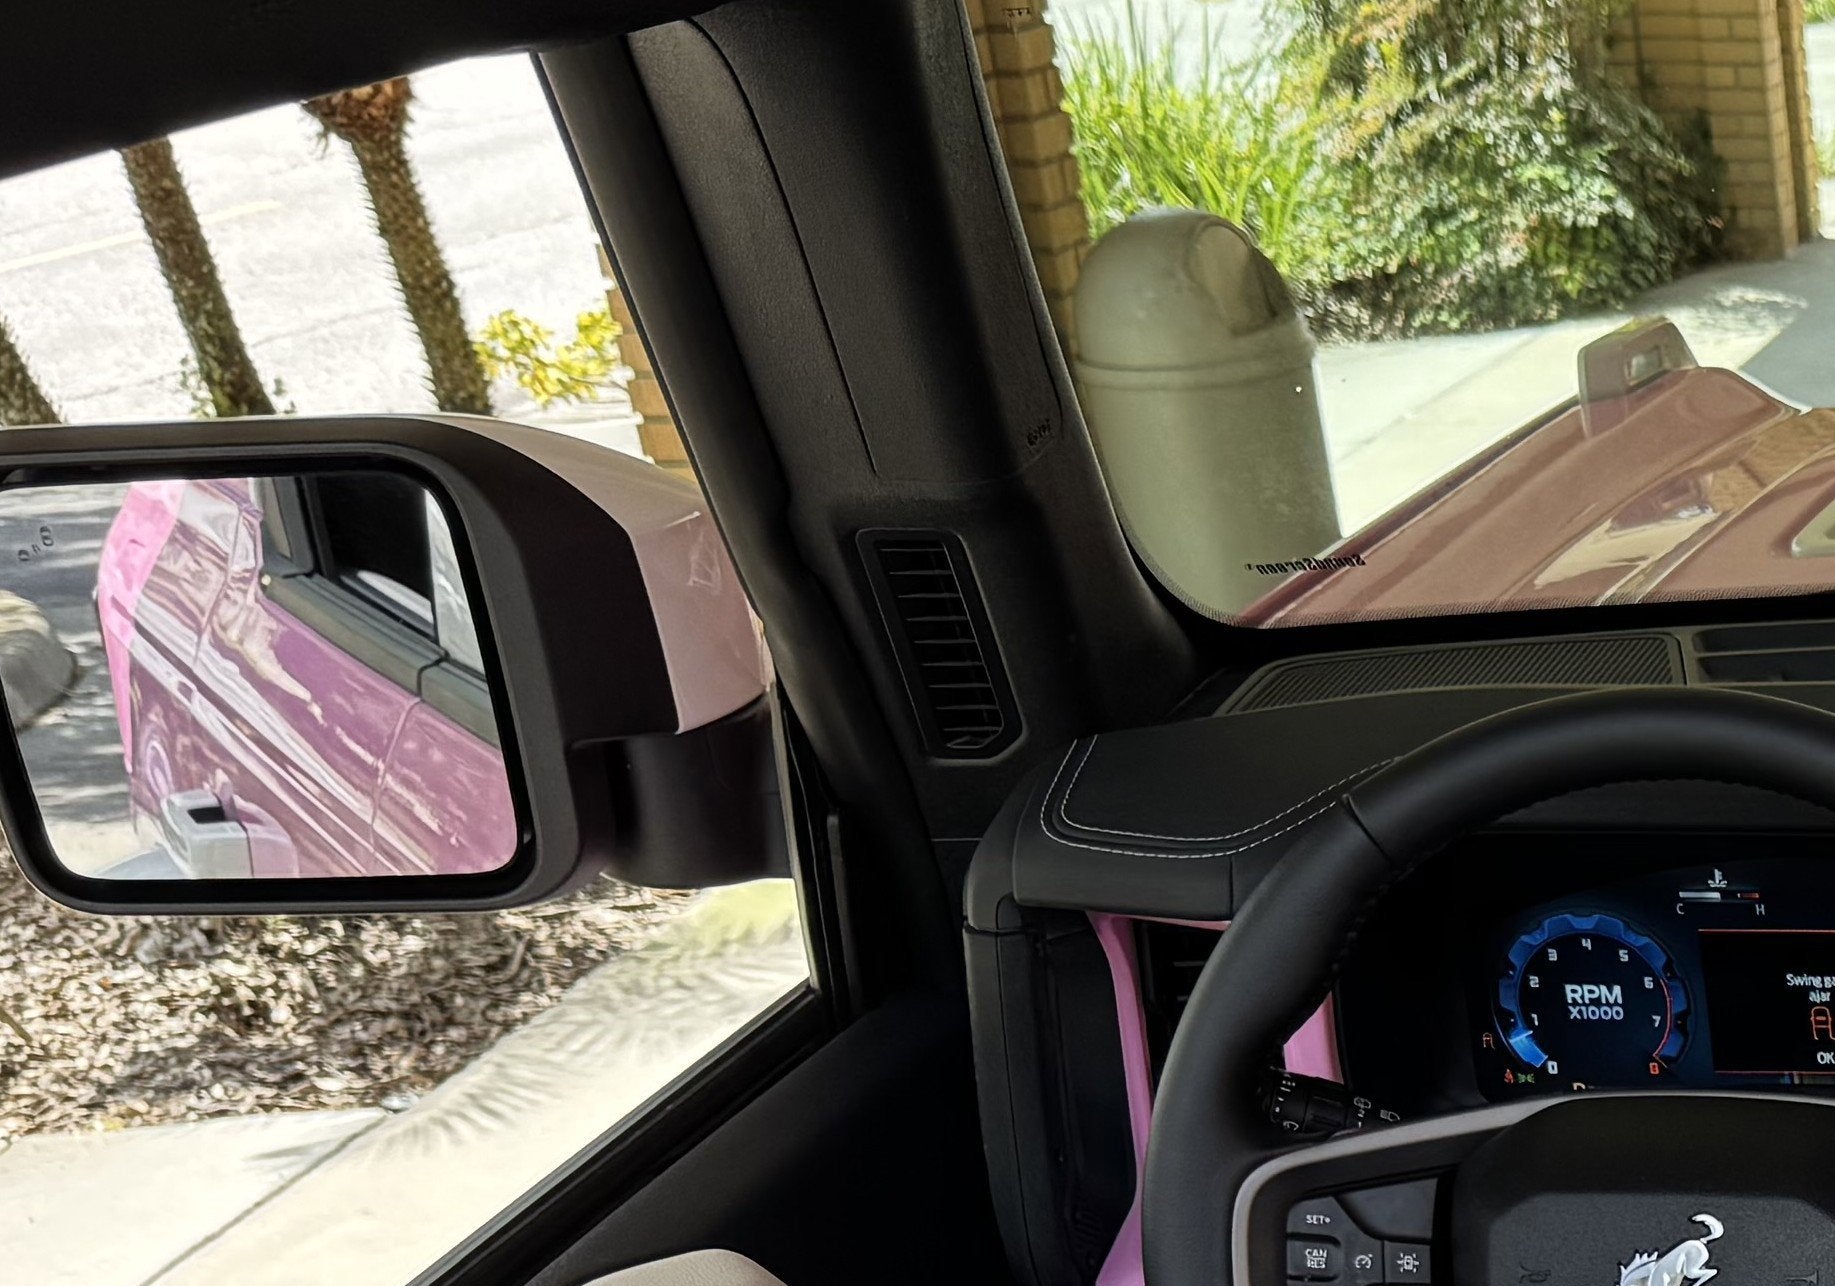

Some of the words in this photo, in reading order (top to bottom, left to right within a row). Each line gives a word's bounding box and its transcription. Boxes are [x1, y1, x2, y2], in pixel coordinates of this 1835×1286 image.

[1676, 903, 1684, 914] C
[1755, 904, 1765, 915] H
[1582, 938, 1592, 950] 4
[1529, 976, 1539, 988] 2
[1786, 974, 1822, 988] Swing
[1565, 984, 1623, 1004] RPM
[1652, 1015, 1661, 1027] 7
[1817, 1052, 1835, 1065] OK
[1547, 1061, 1558, 1074] 0
